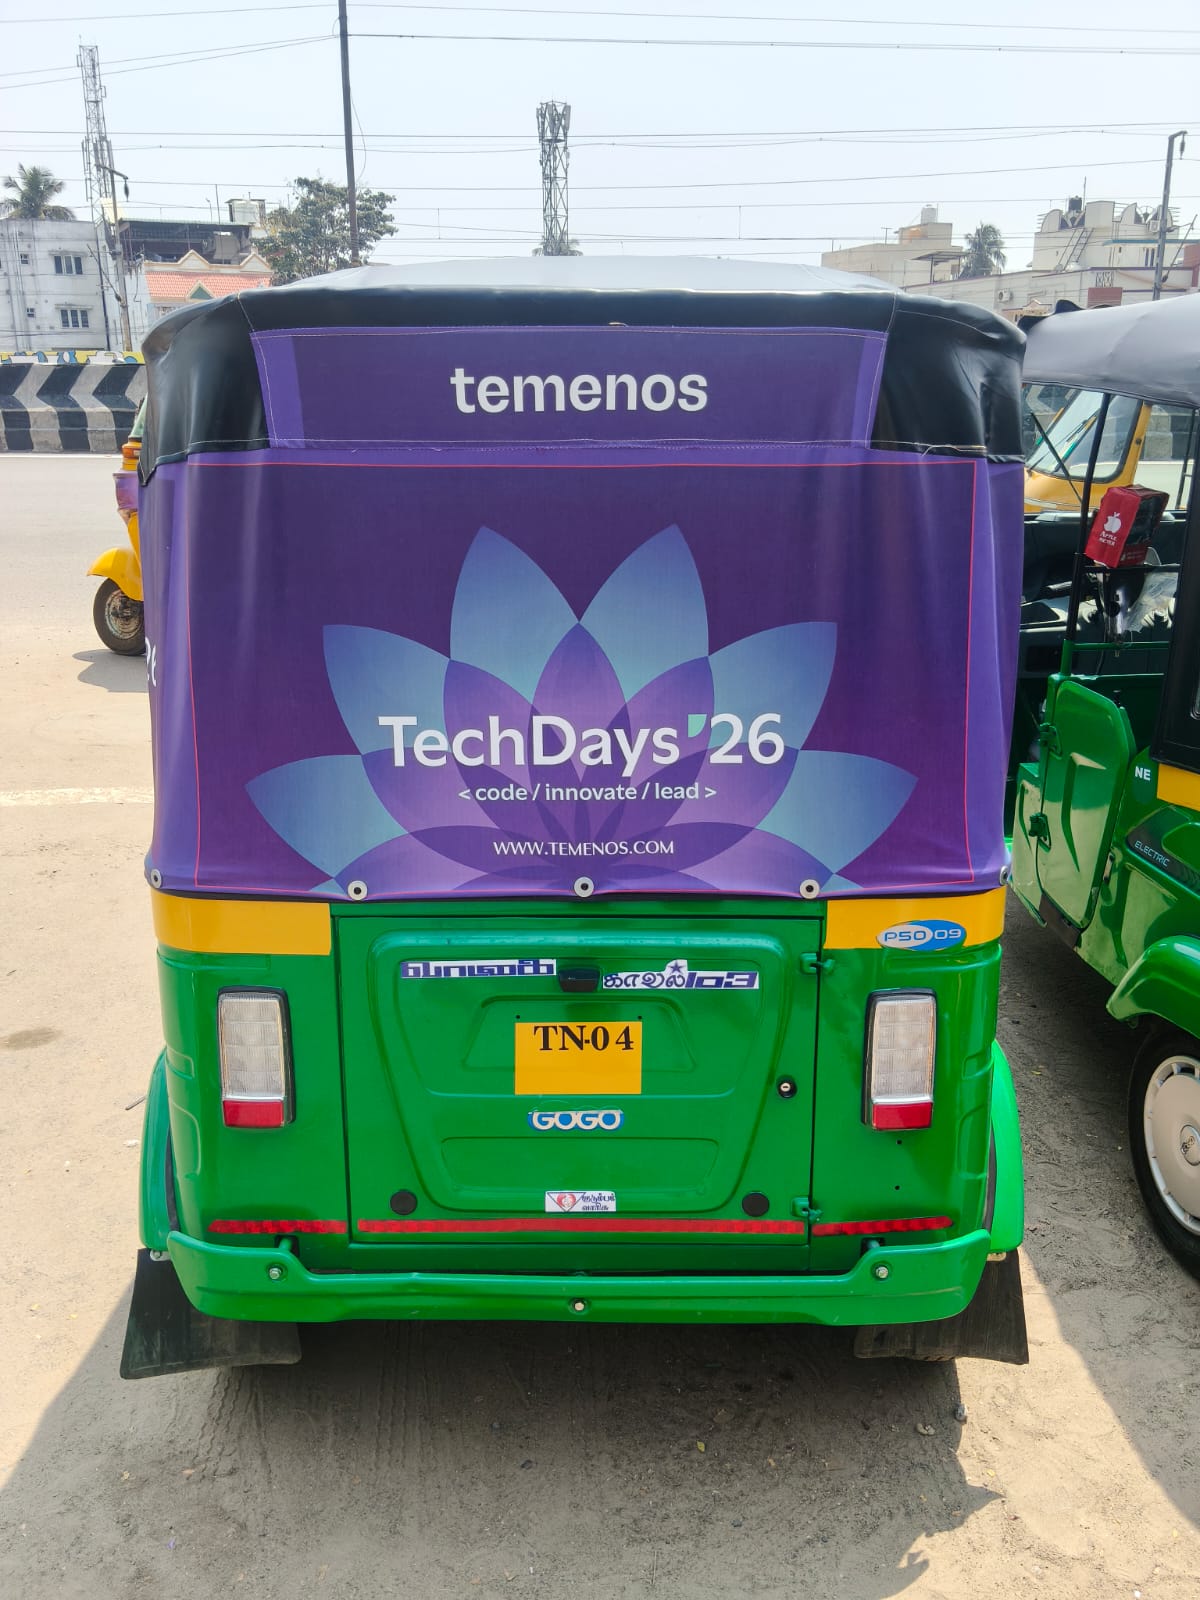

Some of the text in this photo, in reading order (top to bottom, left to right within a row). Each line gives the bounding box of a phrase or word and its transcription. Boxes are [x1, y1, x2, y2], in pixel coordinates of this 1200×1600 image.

[450, 368, 708, 413] temenos
[378, 715, 680, 777] TechDays
[475, 783, 528, 801] code
[545, 784, 637, 801] innovate
[655, 782, 699, 799] lead
[493, 840, 675, 856] WWW.TEMENOS.COM
[1134, 840, 1170, 867] ELECTRIC
[934, 928, 962, 940] 09
[532, 1110, 621, 1130] GOGO
